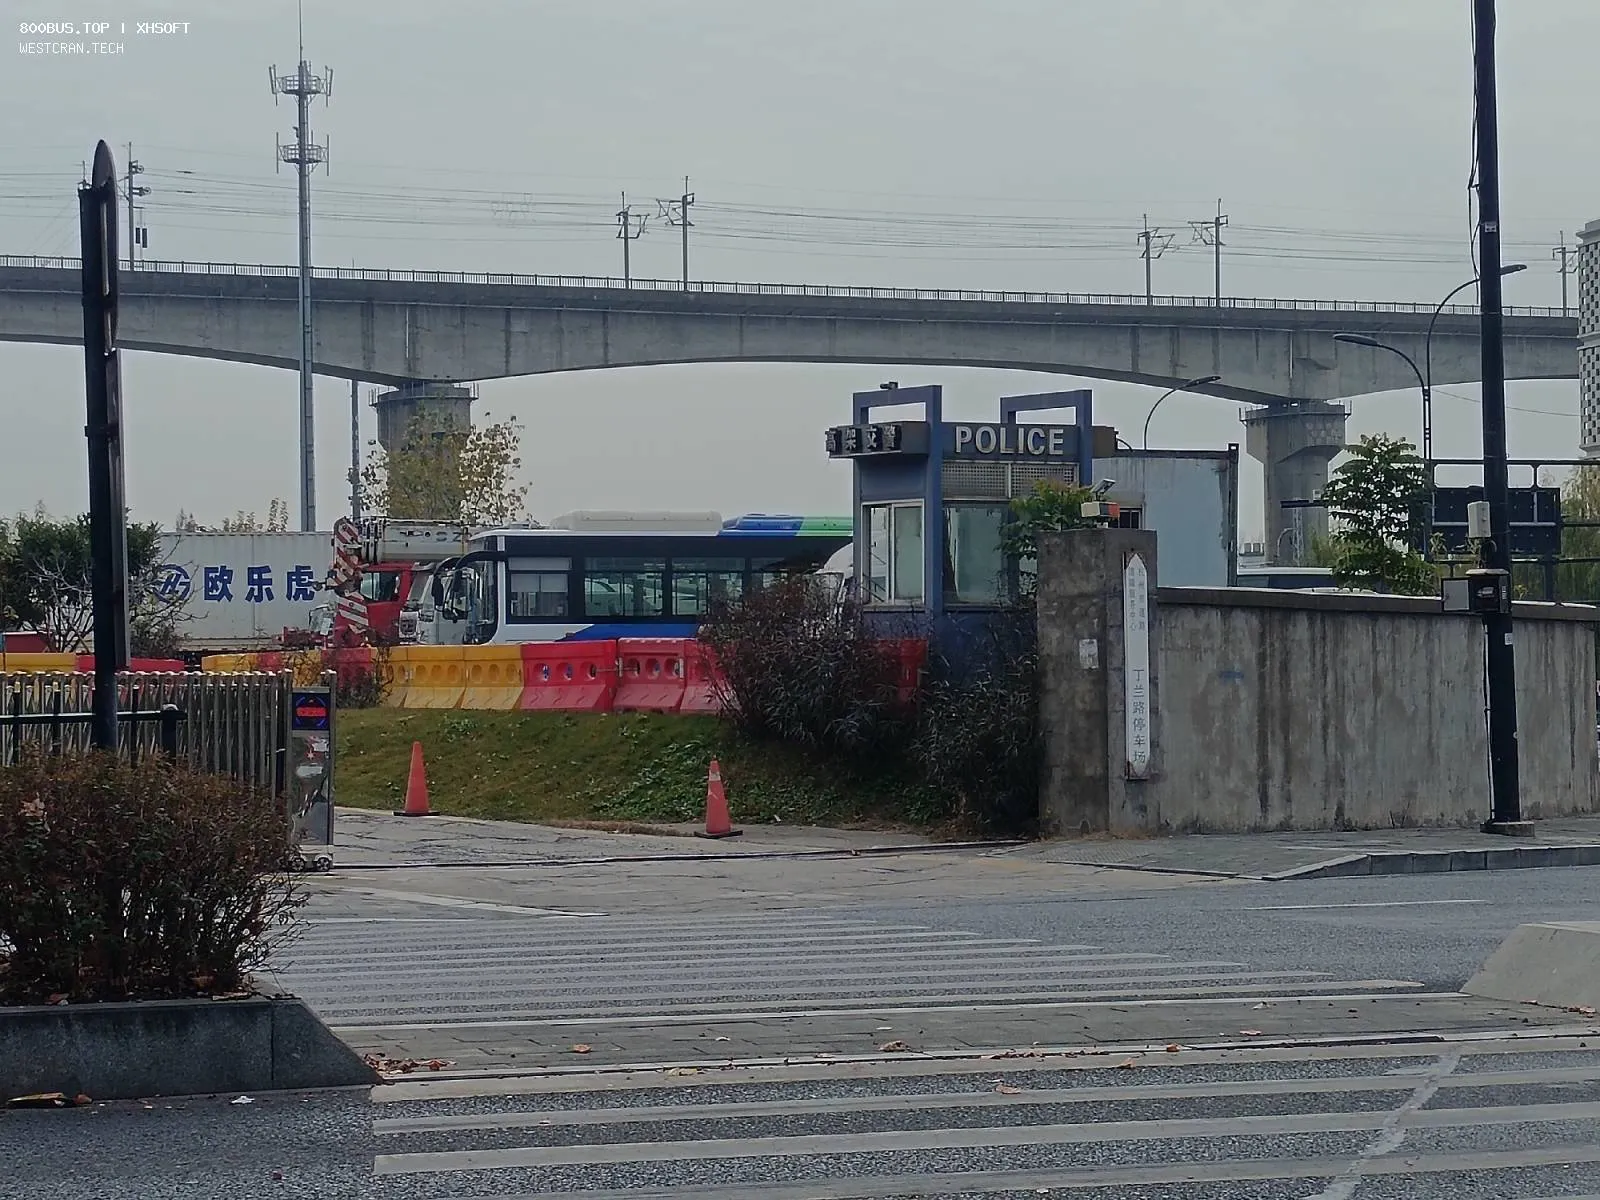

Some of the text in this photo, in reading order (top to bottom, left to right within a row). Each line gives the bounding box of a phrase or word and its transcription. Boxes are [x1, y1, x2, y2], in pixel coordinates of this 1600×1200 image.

[825, 424, 899, 453] 高架交警
[955, 425, 1065, 455] POLICE
[203, 564, 316, 603] 欧乐虎
[1132, 669, 1147, 764] 丁兰路停车场
